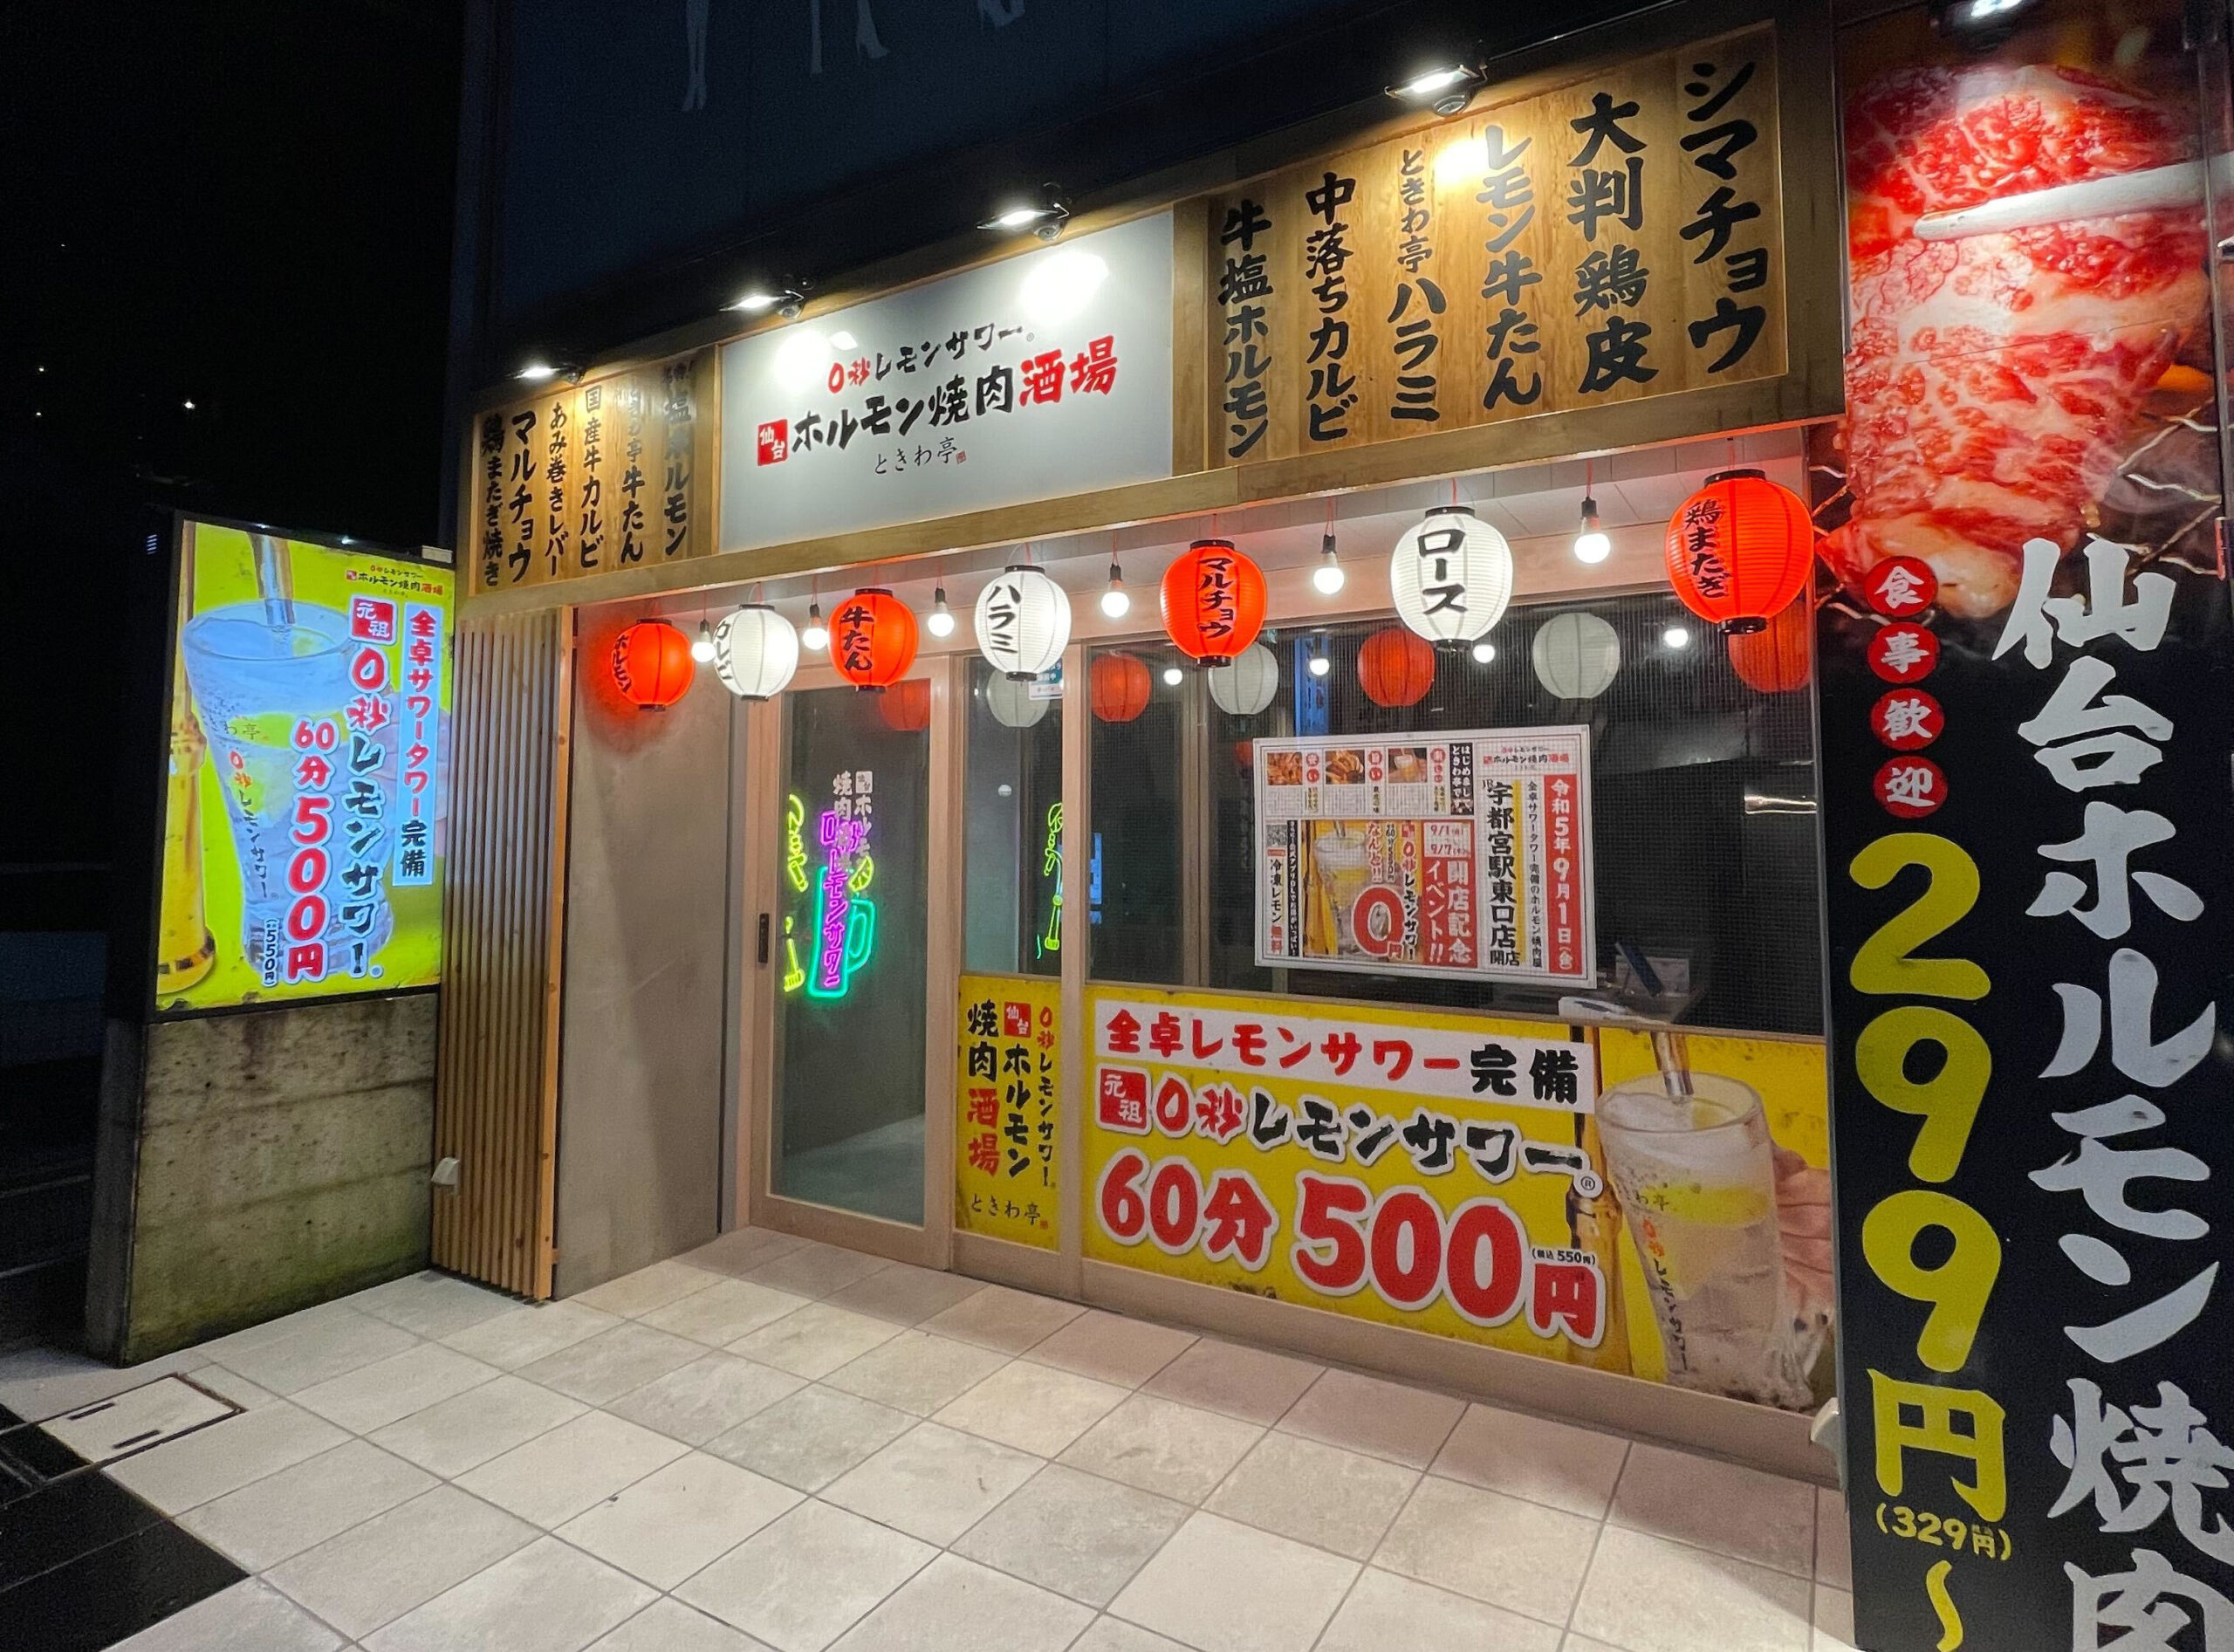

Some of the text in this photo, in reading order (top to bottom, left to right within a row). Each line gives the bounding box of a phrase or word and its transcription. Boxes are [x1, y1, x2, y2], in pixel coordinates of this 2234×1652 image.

[1388, 149, 1447, 422] ときわ亭ハラミ
[1476, 125, 1543, 410] レモン牛たん
[1567, 93, 1659, 394] 大判鶏皮
[1680, 62, 1770, 374] シマチョウ
[1217, 199, 1273, 458] 牛塩ホルモン
[1305, 172, 1358, 441] 中落ちカルビ
[509, 410, 537, 582] マルチョウ
[545, 402, 569, 576] あみ巻きレバー
[580, 385, 604, 568] 国産牛カルビ
[875, 436, 959, 476] ときわ亭
[356, 602, 390, 638] 元祖
[840, 607, 874, 672] 牛たん
[987, 584, 1021, 655] ハラミ
[1198, 558, 1236, 639] マルチョウ
[1417, 529, 1469, 615] ロース
[401, 610, 437, 876] 全卓サワータワー完備
[1874, 566, 1937, 807] 食事歓迎
[967, 998, 1001, 1177] 焼肉酒場
[1003, 1043, 1031, 1178] ホルモン
[1104, 1073, 1144, 1124] 元祖
[1106, 1008, 1578, 1105] 全卓レモンサワー完備
[970, 1193, 1042, 1226] ときわ亭
[1101, 1154, 1599, 1340] 60分 500円
